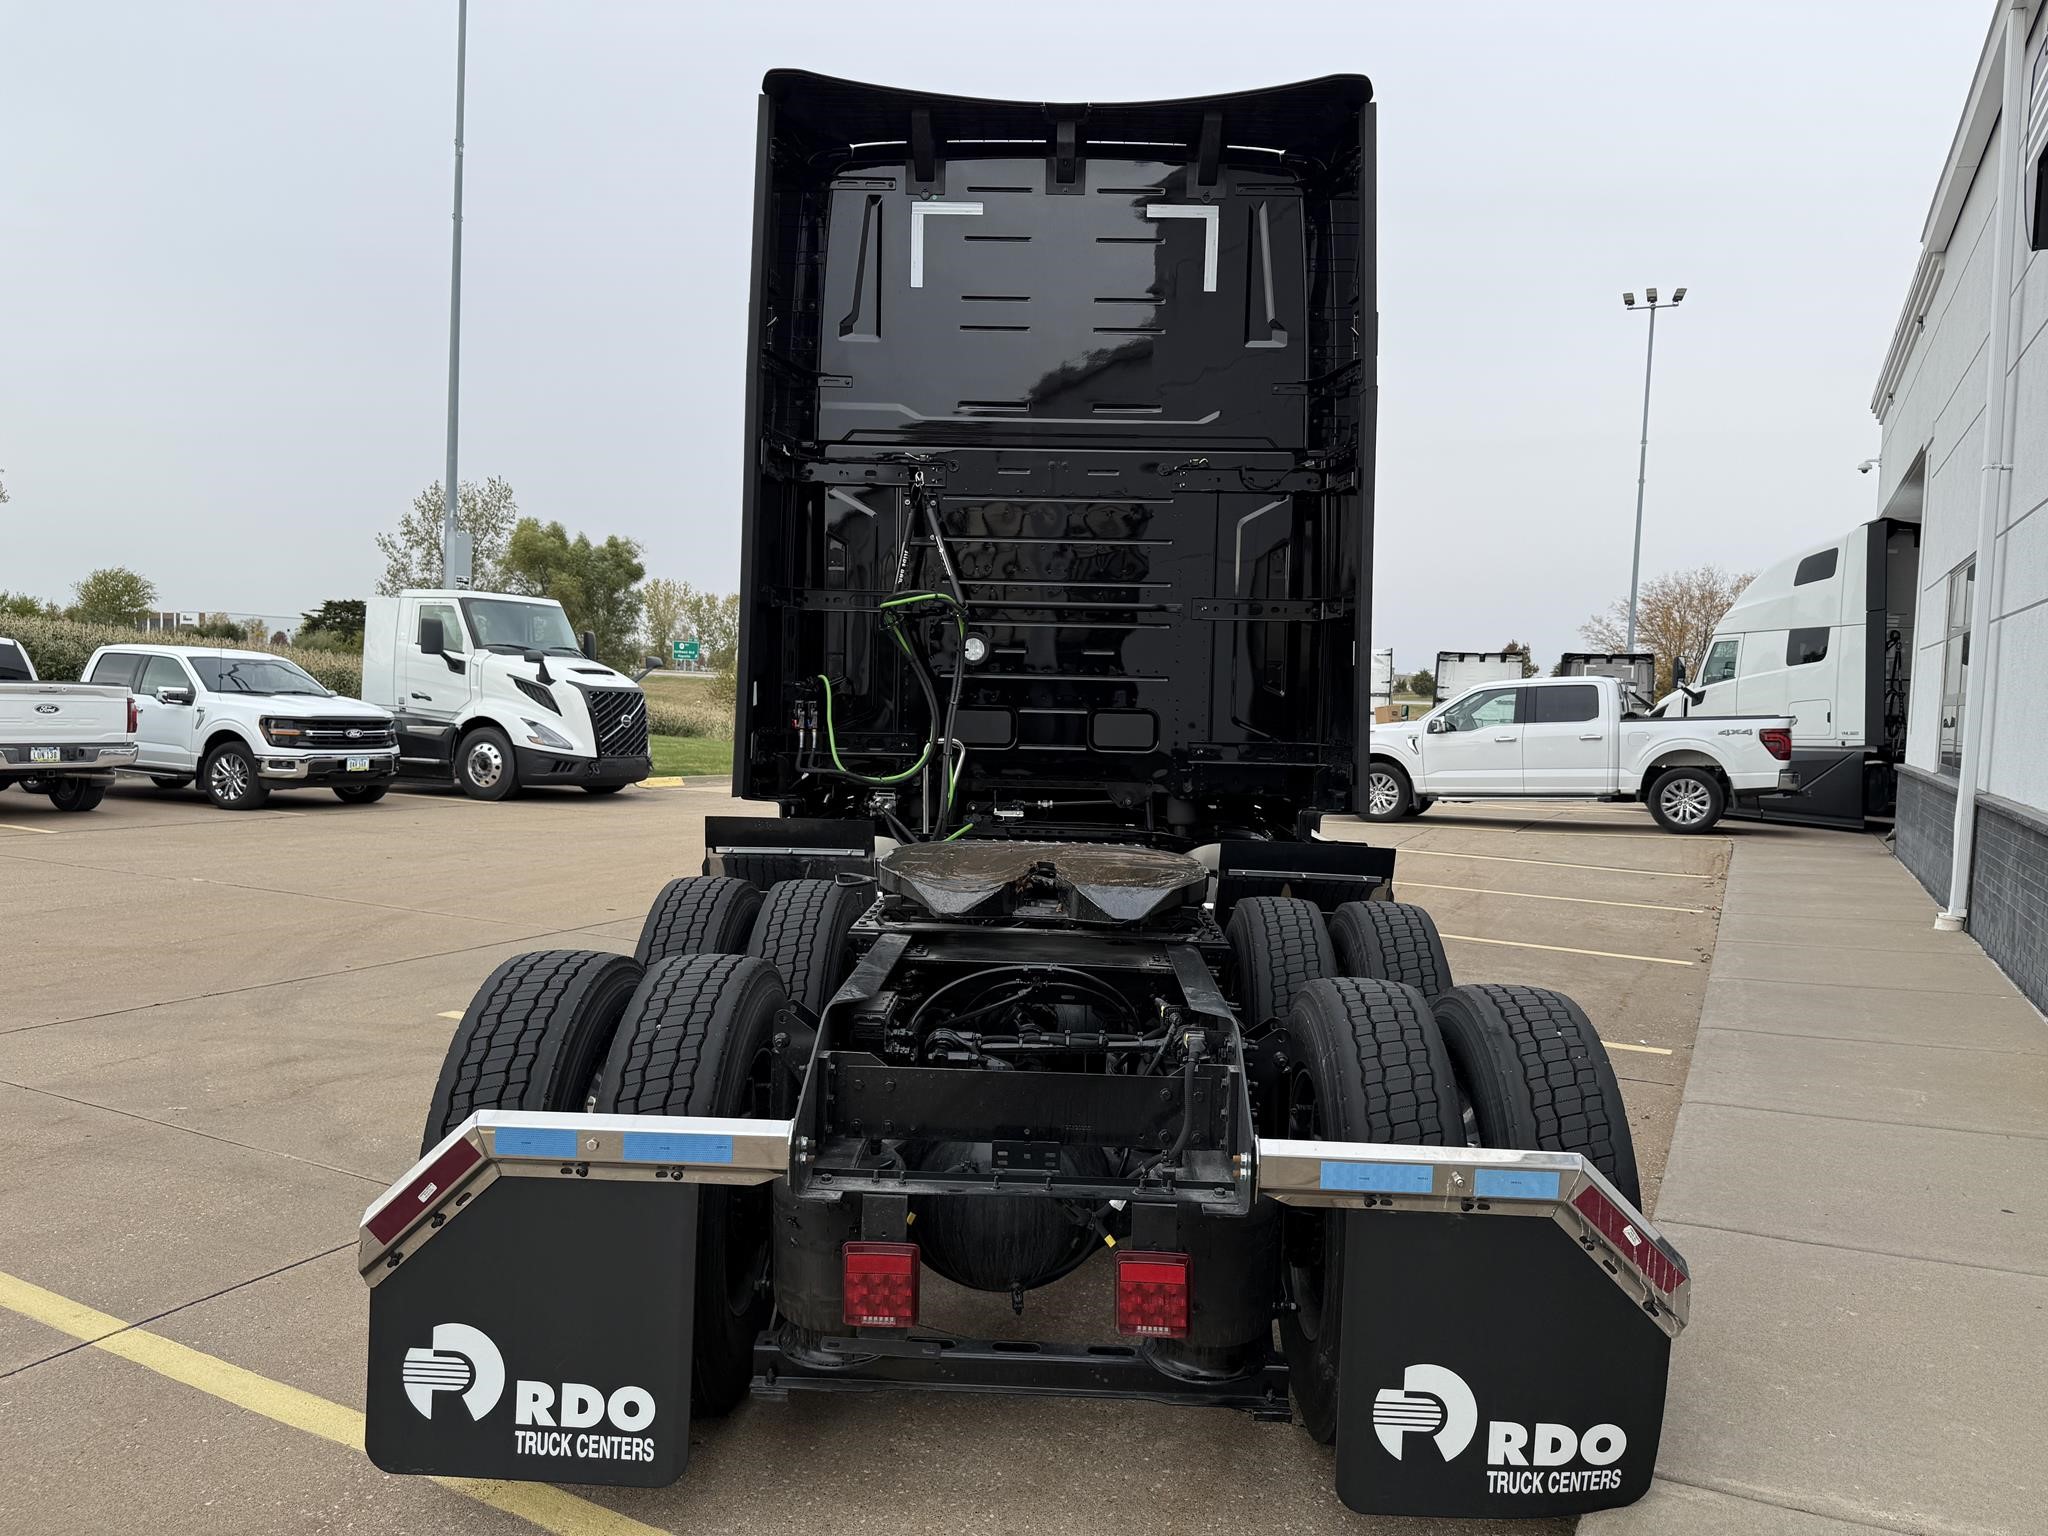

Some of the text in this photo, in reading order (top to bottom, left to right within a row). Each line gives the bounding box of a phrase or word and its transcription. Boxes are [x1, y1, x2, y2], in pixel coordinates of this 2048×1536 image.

[38, 704, 57, 713] Ford
[514, 1379, 656, 1433] RDO
[514, 1430, 655, 1463] TRUCK CENTERS
[1487, 1420, 1627, 1467] RDO
[1486, 1468, 1622, 1495] TRUCK CENTERS
